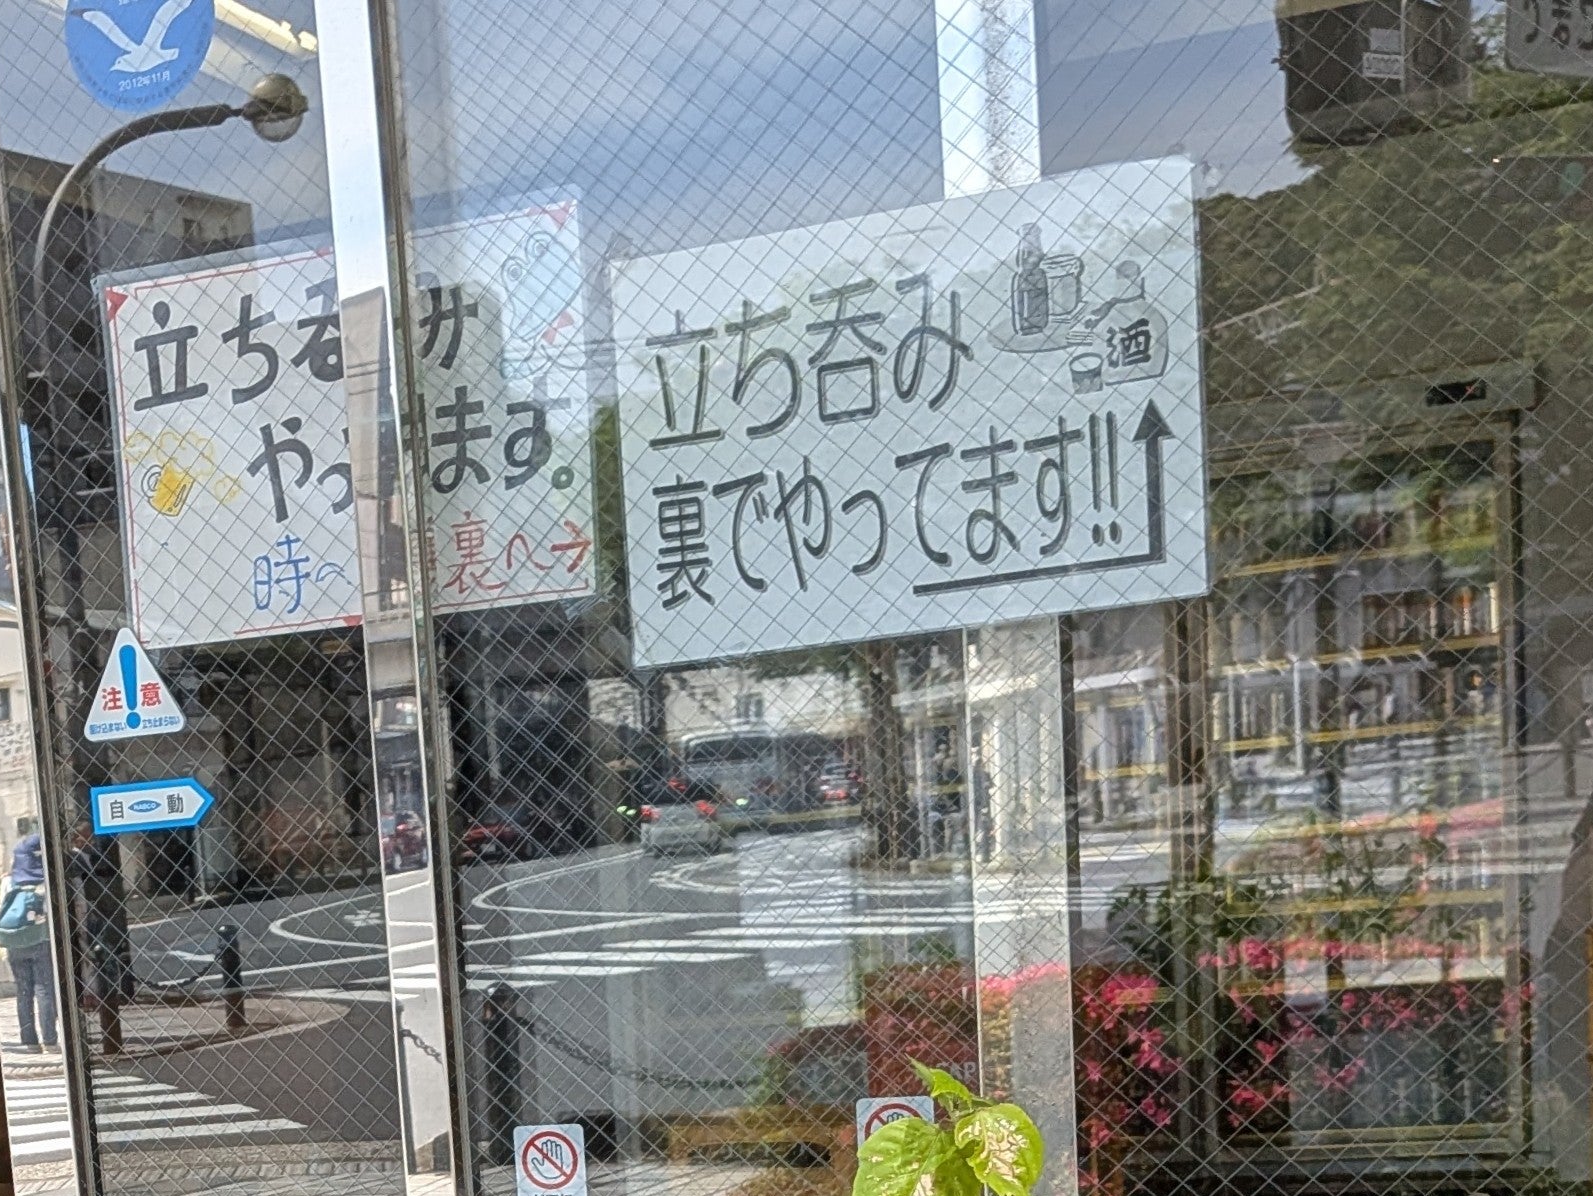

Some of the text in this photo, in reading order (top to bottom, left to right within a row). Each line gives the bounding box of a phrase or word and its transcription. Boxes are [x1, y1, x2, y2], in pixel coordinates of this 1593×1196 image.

[118, 69, 171, 92] 2012年11月
[644, 272, 975, 450] 立ち呑み
[1106, 317, 1152, 369] 酒
